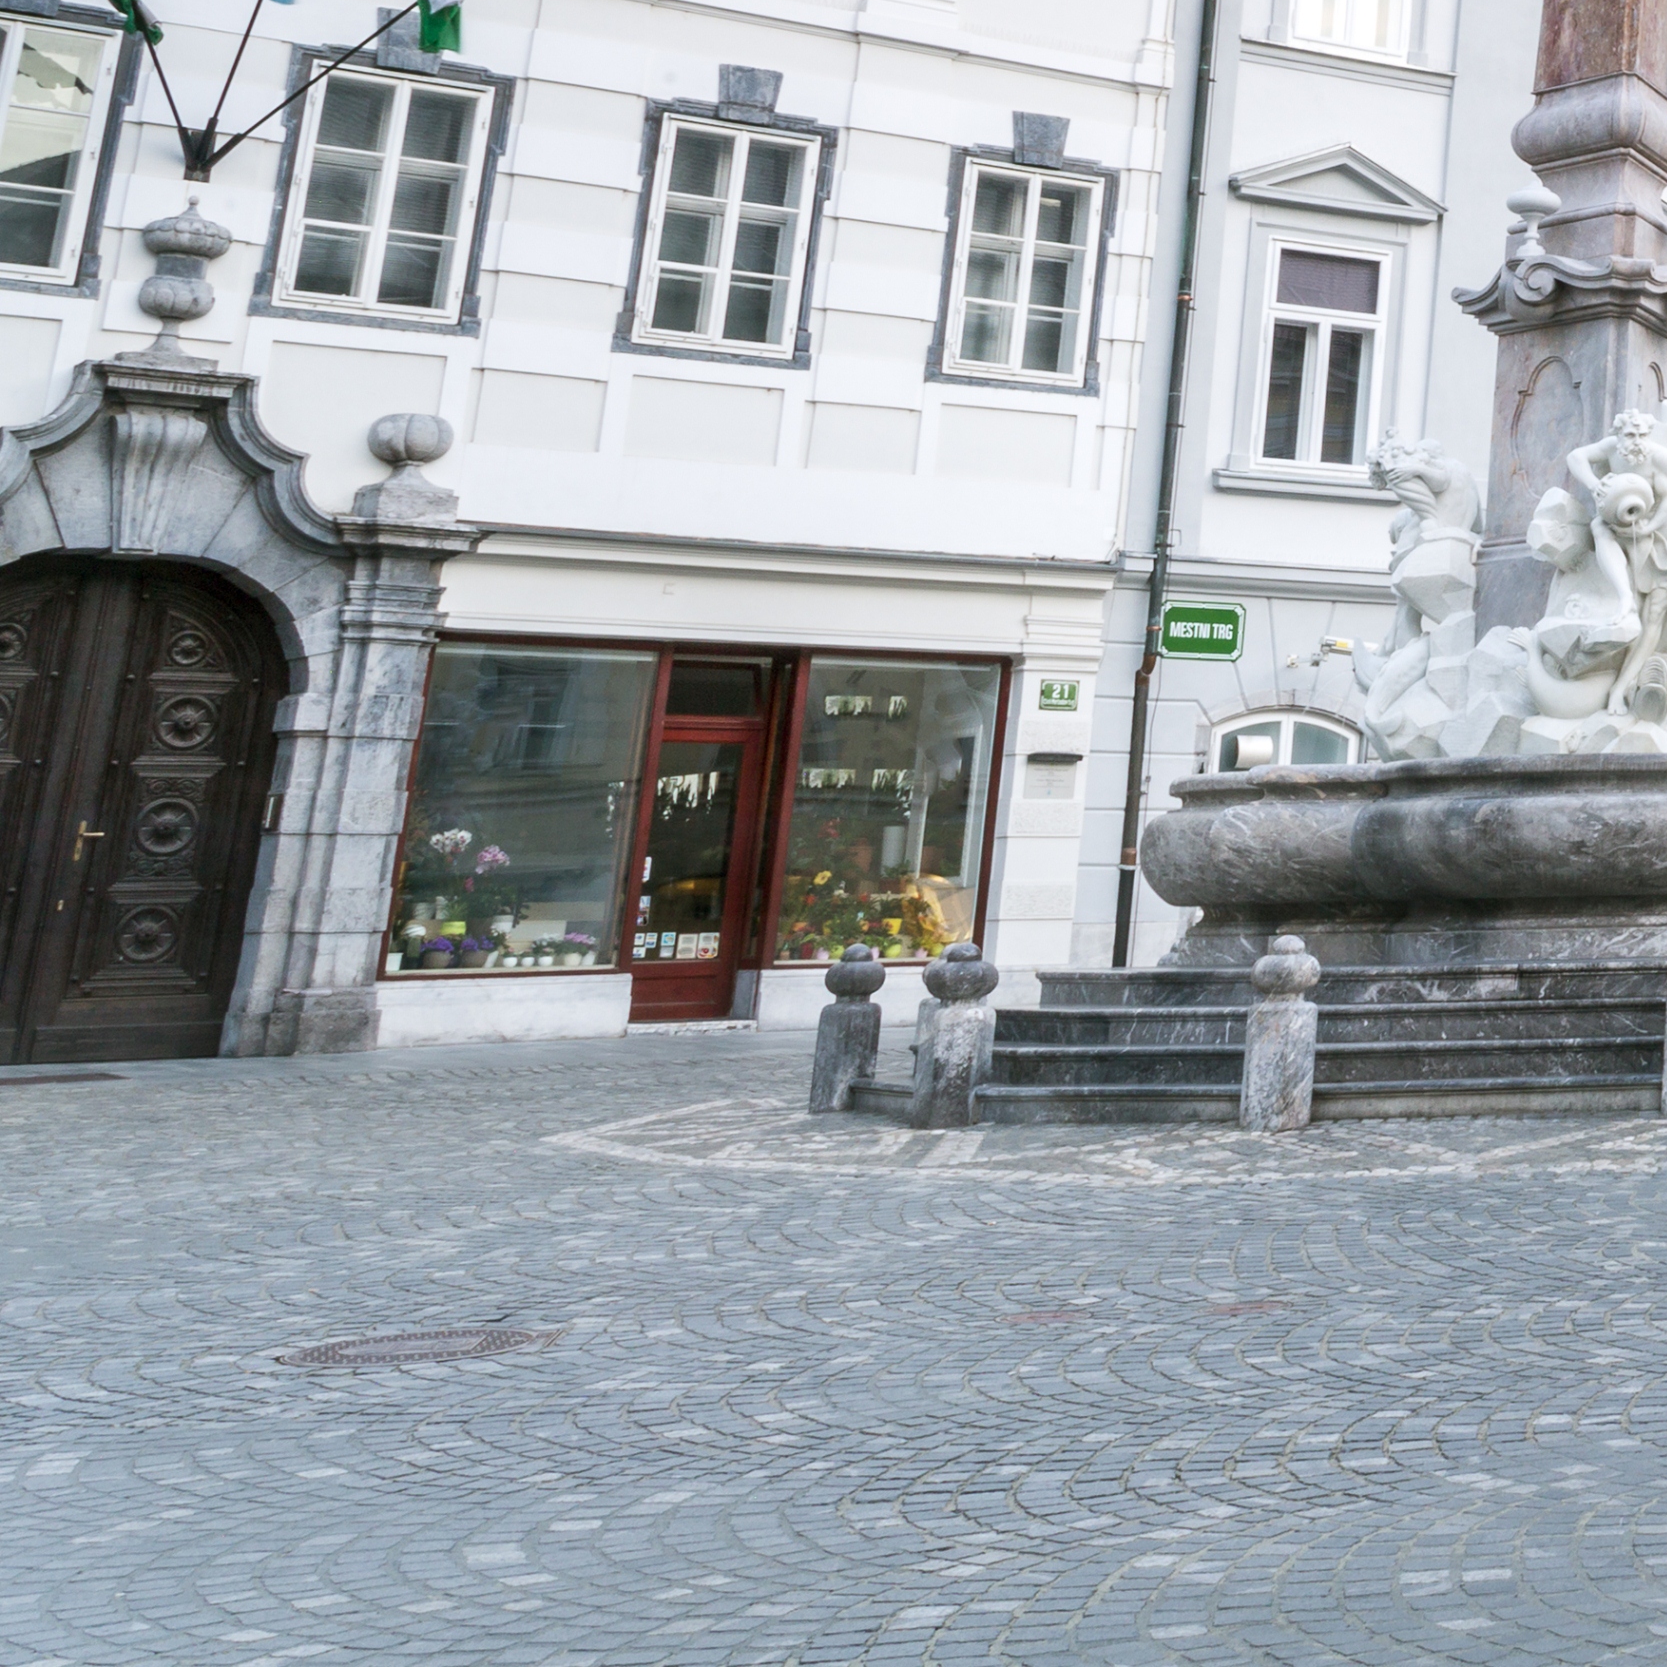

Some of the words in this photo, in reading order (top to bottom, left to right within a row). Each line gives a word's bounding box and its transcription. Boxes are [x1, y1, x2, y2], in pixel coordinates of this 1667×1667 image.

[1169, 621, 1211, 639] MESTNI
[1212, 623, 1234, 640] TRG
[1052, 684, 1069, 699] 21
